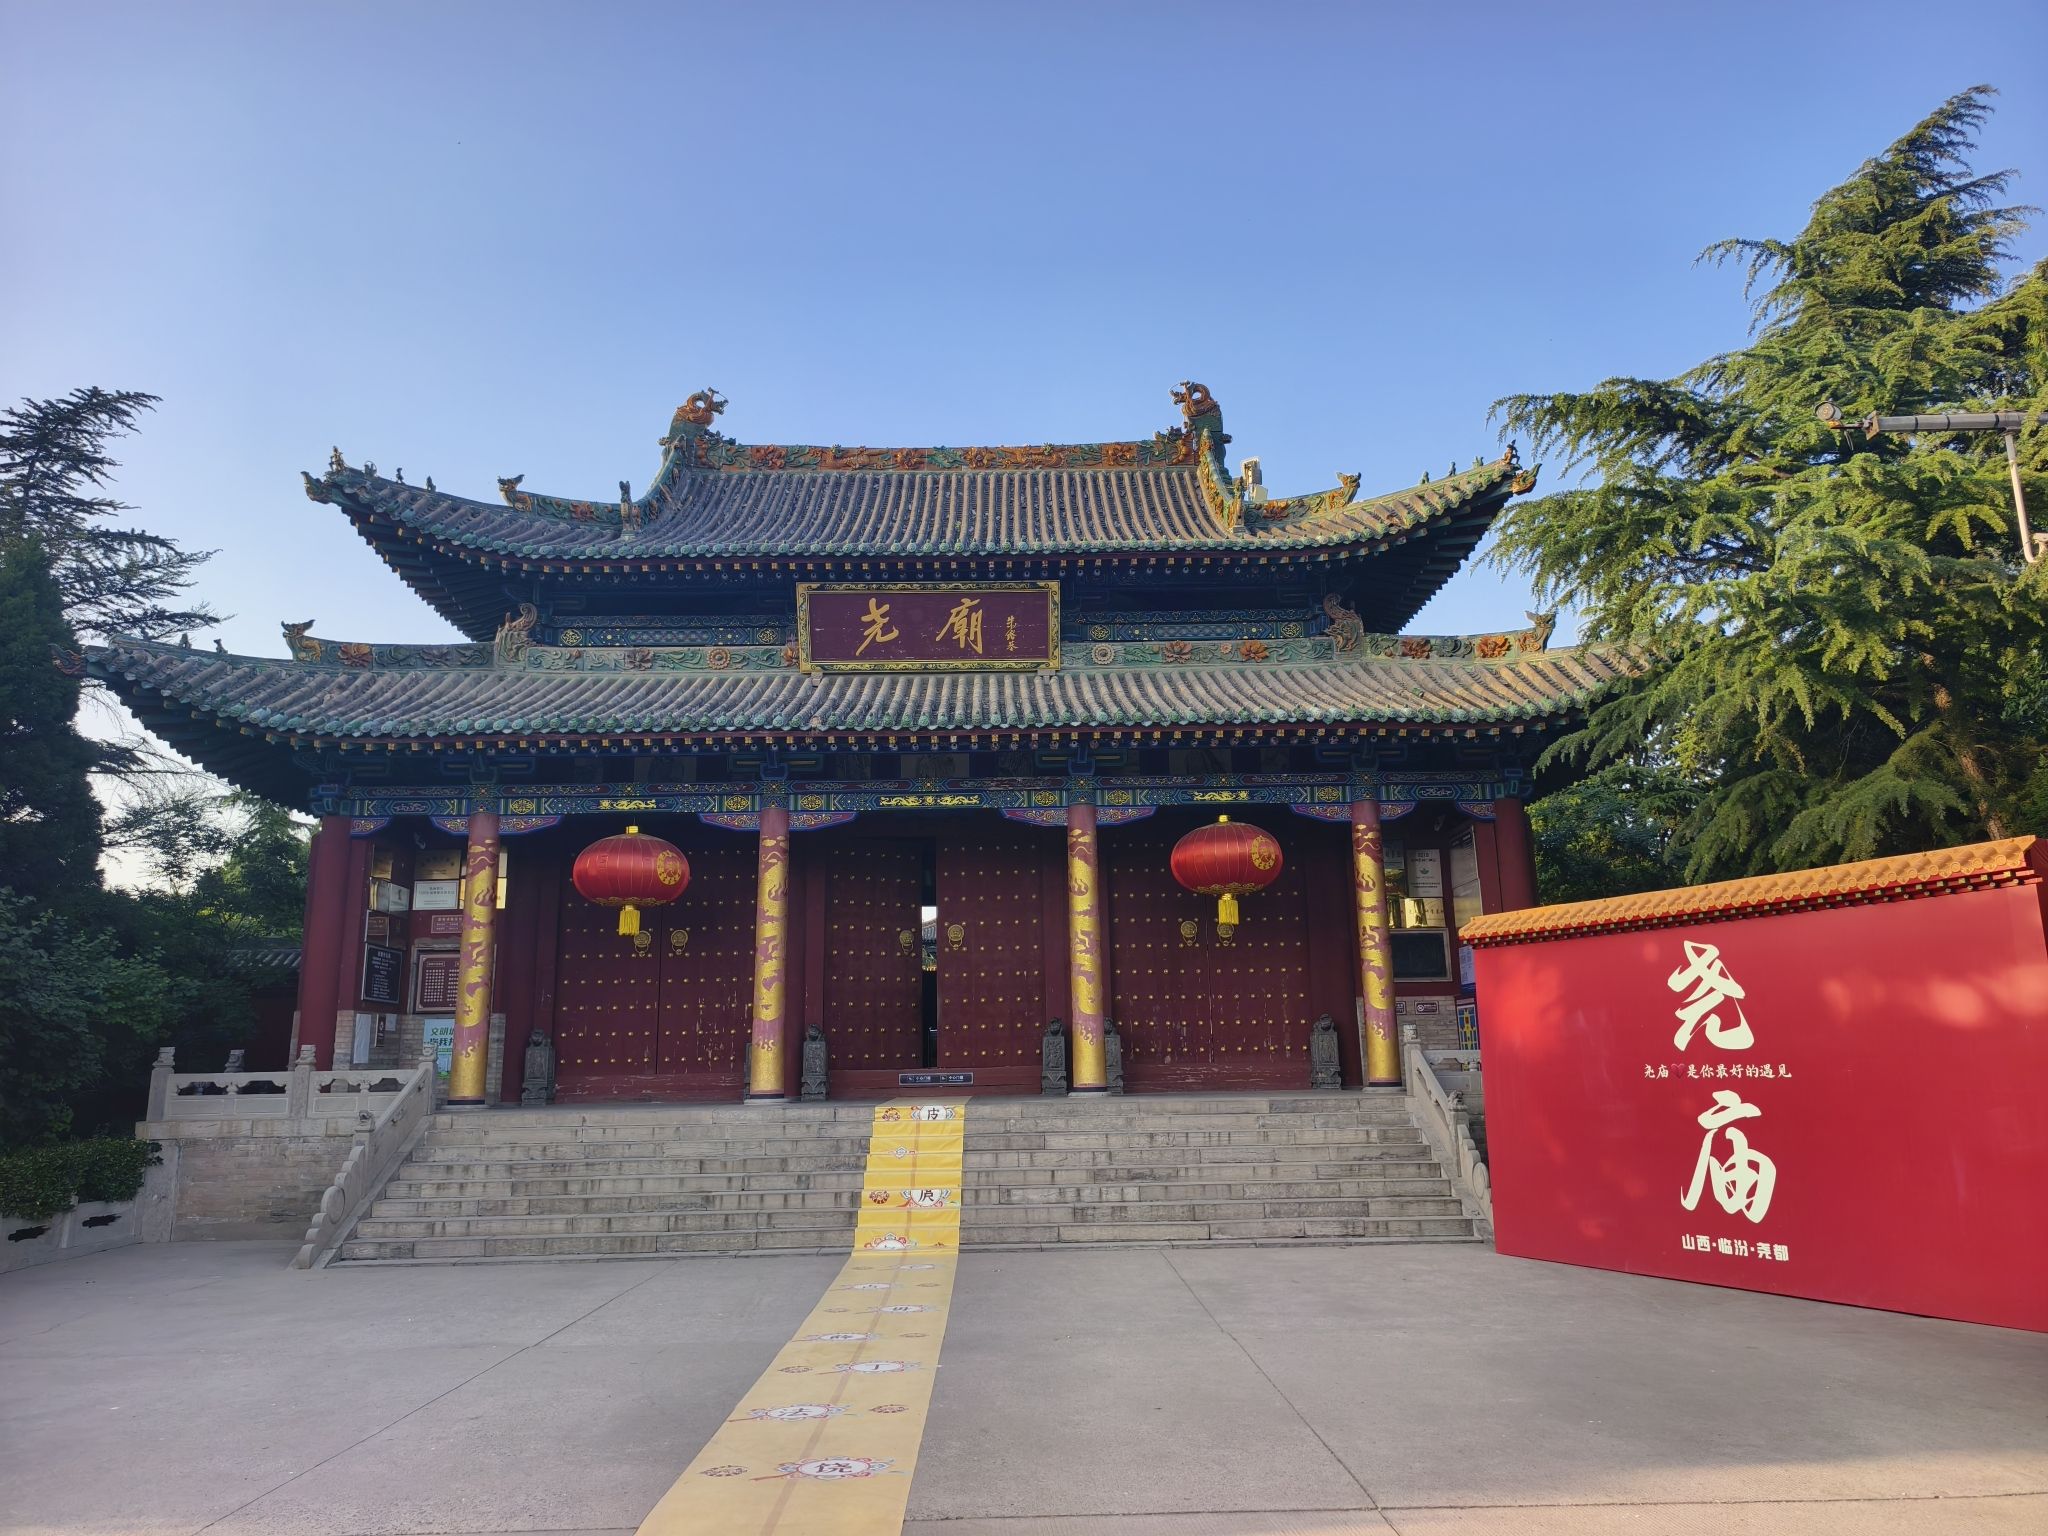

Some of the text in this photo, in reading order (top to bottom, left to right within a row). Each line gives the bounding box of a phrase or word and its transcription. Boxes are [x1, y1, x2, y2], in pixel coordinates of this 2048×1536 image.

[1667, 940, 1755, 1051] 尧
[1644, 1063, 1793, 1079] 尧庙 是你最好的遇见
[1680, 1089, 1777, 1223] 庙
[814, 1462, 852, 1474] 饶
